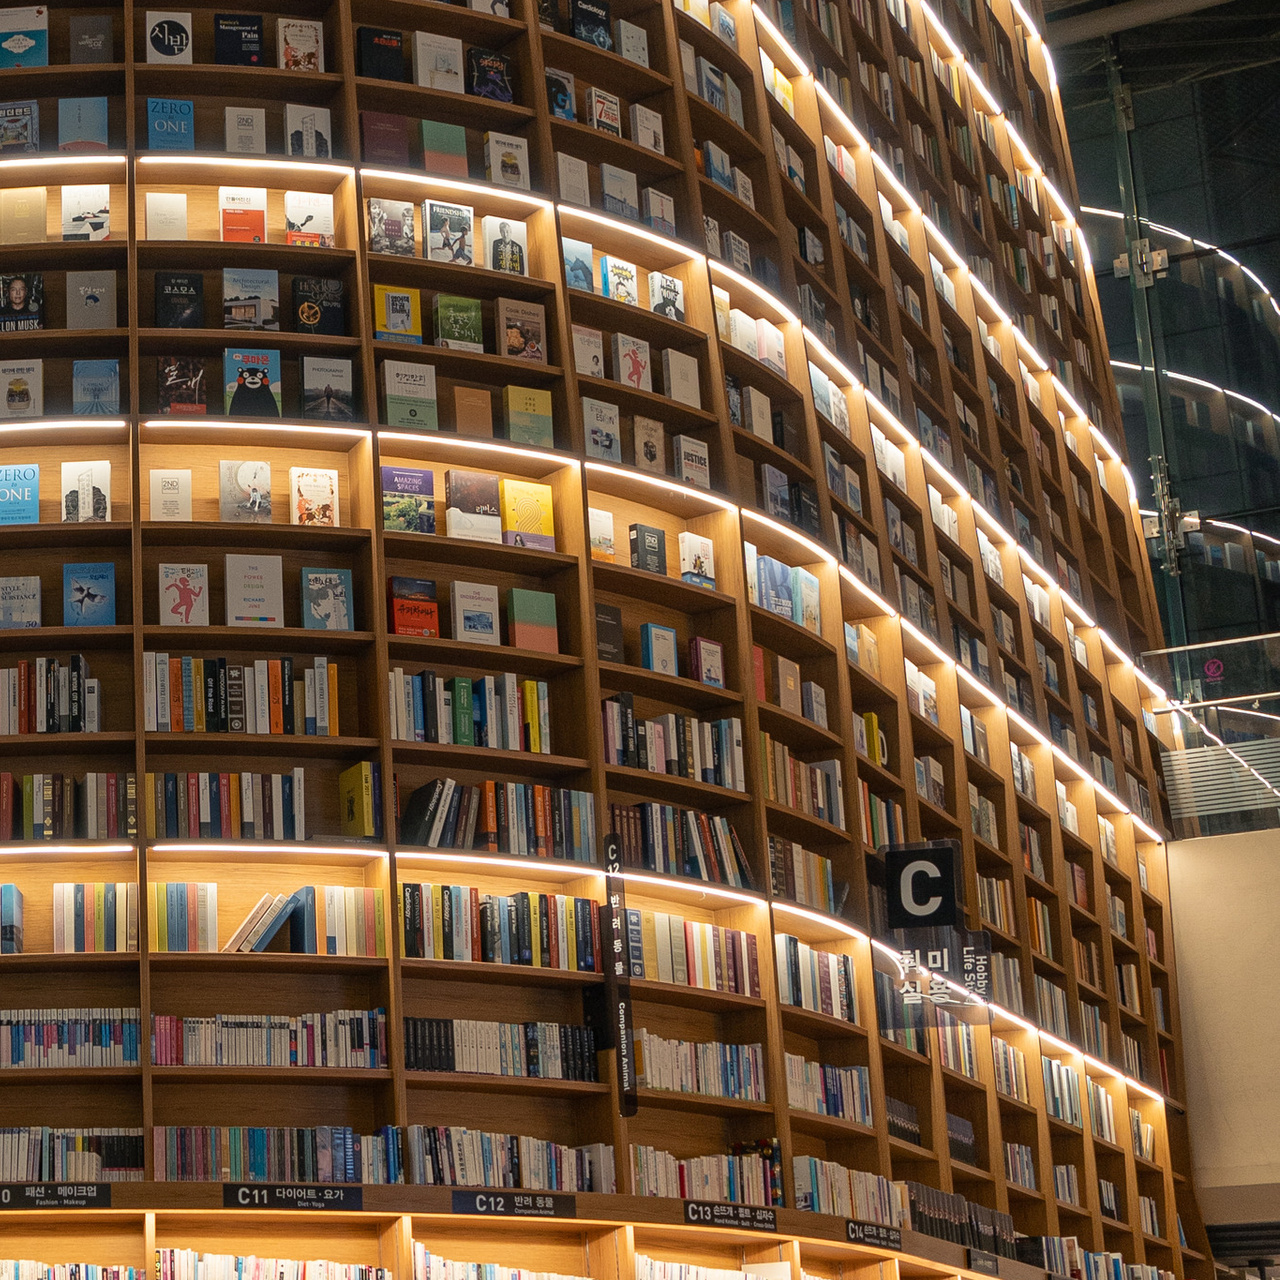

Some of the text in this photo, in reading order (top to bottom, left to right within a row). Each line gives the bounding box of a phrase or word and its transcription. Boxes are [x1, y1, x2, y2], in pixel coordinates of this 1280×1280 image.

[151, 23, 190, 55] 시밤
[241, 31, 260, 41] Pain
[151, 100, 192, 116] ZERO
[154, 120, 189, 135] ONE
[163, 284, 197, 295] 코스모스
[505, 306, 540, 318] Cook Dishes
[17, 320, 40, 331] MUSK
[683, 451, 708, 468] JUSTICE
[393, 477, 423, 486] AMAZING
[397, 483, 422, 492] SPACES
[1, 593, 37, 602] SUBSTANCE
[24, 620, 38, 629] 50
[607, 844, 617, 861] C
[900, 860, 943, 917] C
[963, 946, 975, 970] Life
[618, 1002, 631, 1091] Companion Animal
[57, 1185, 98, 1199] 메이크업
[237, 1187, 269, 1205] C11
[35, 1198, 87, 1207] Fashion Makeup
[475, 1194, 555, 1212] C12 반려 동물
[688, 1203, 713, 1220] C13
[848, 1222, 864, 1240] C14
